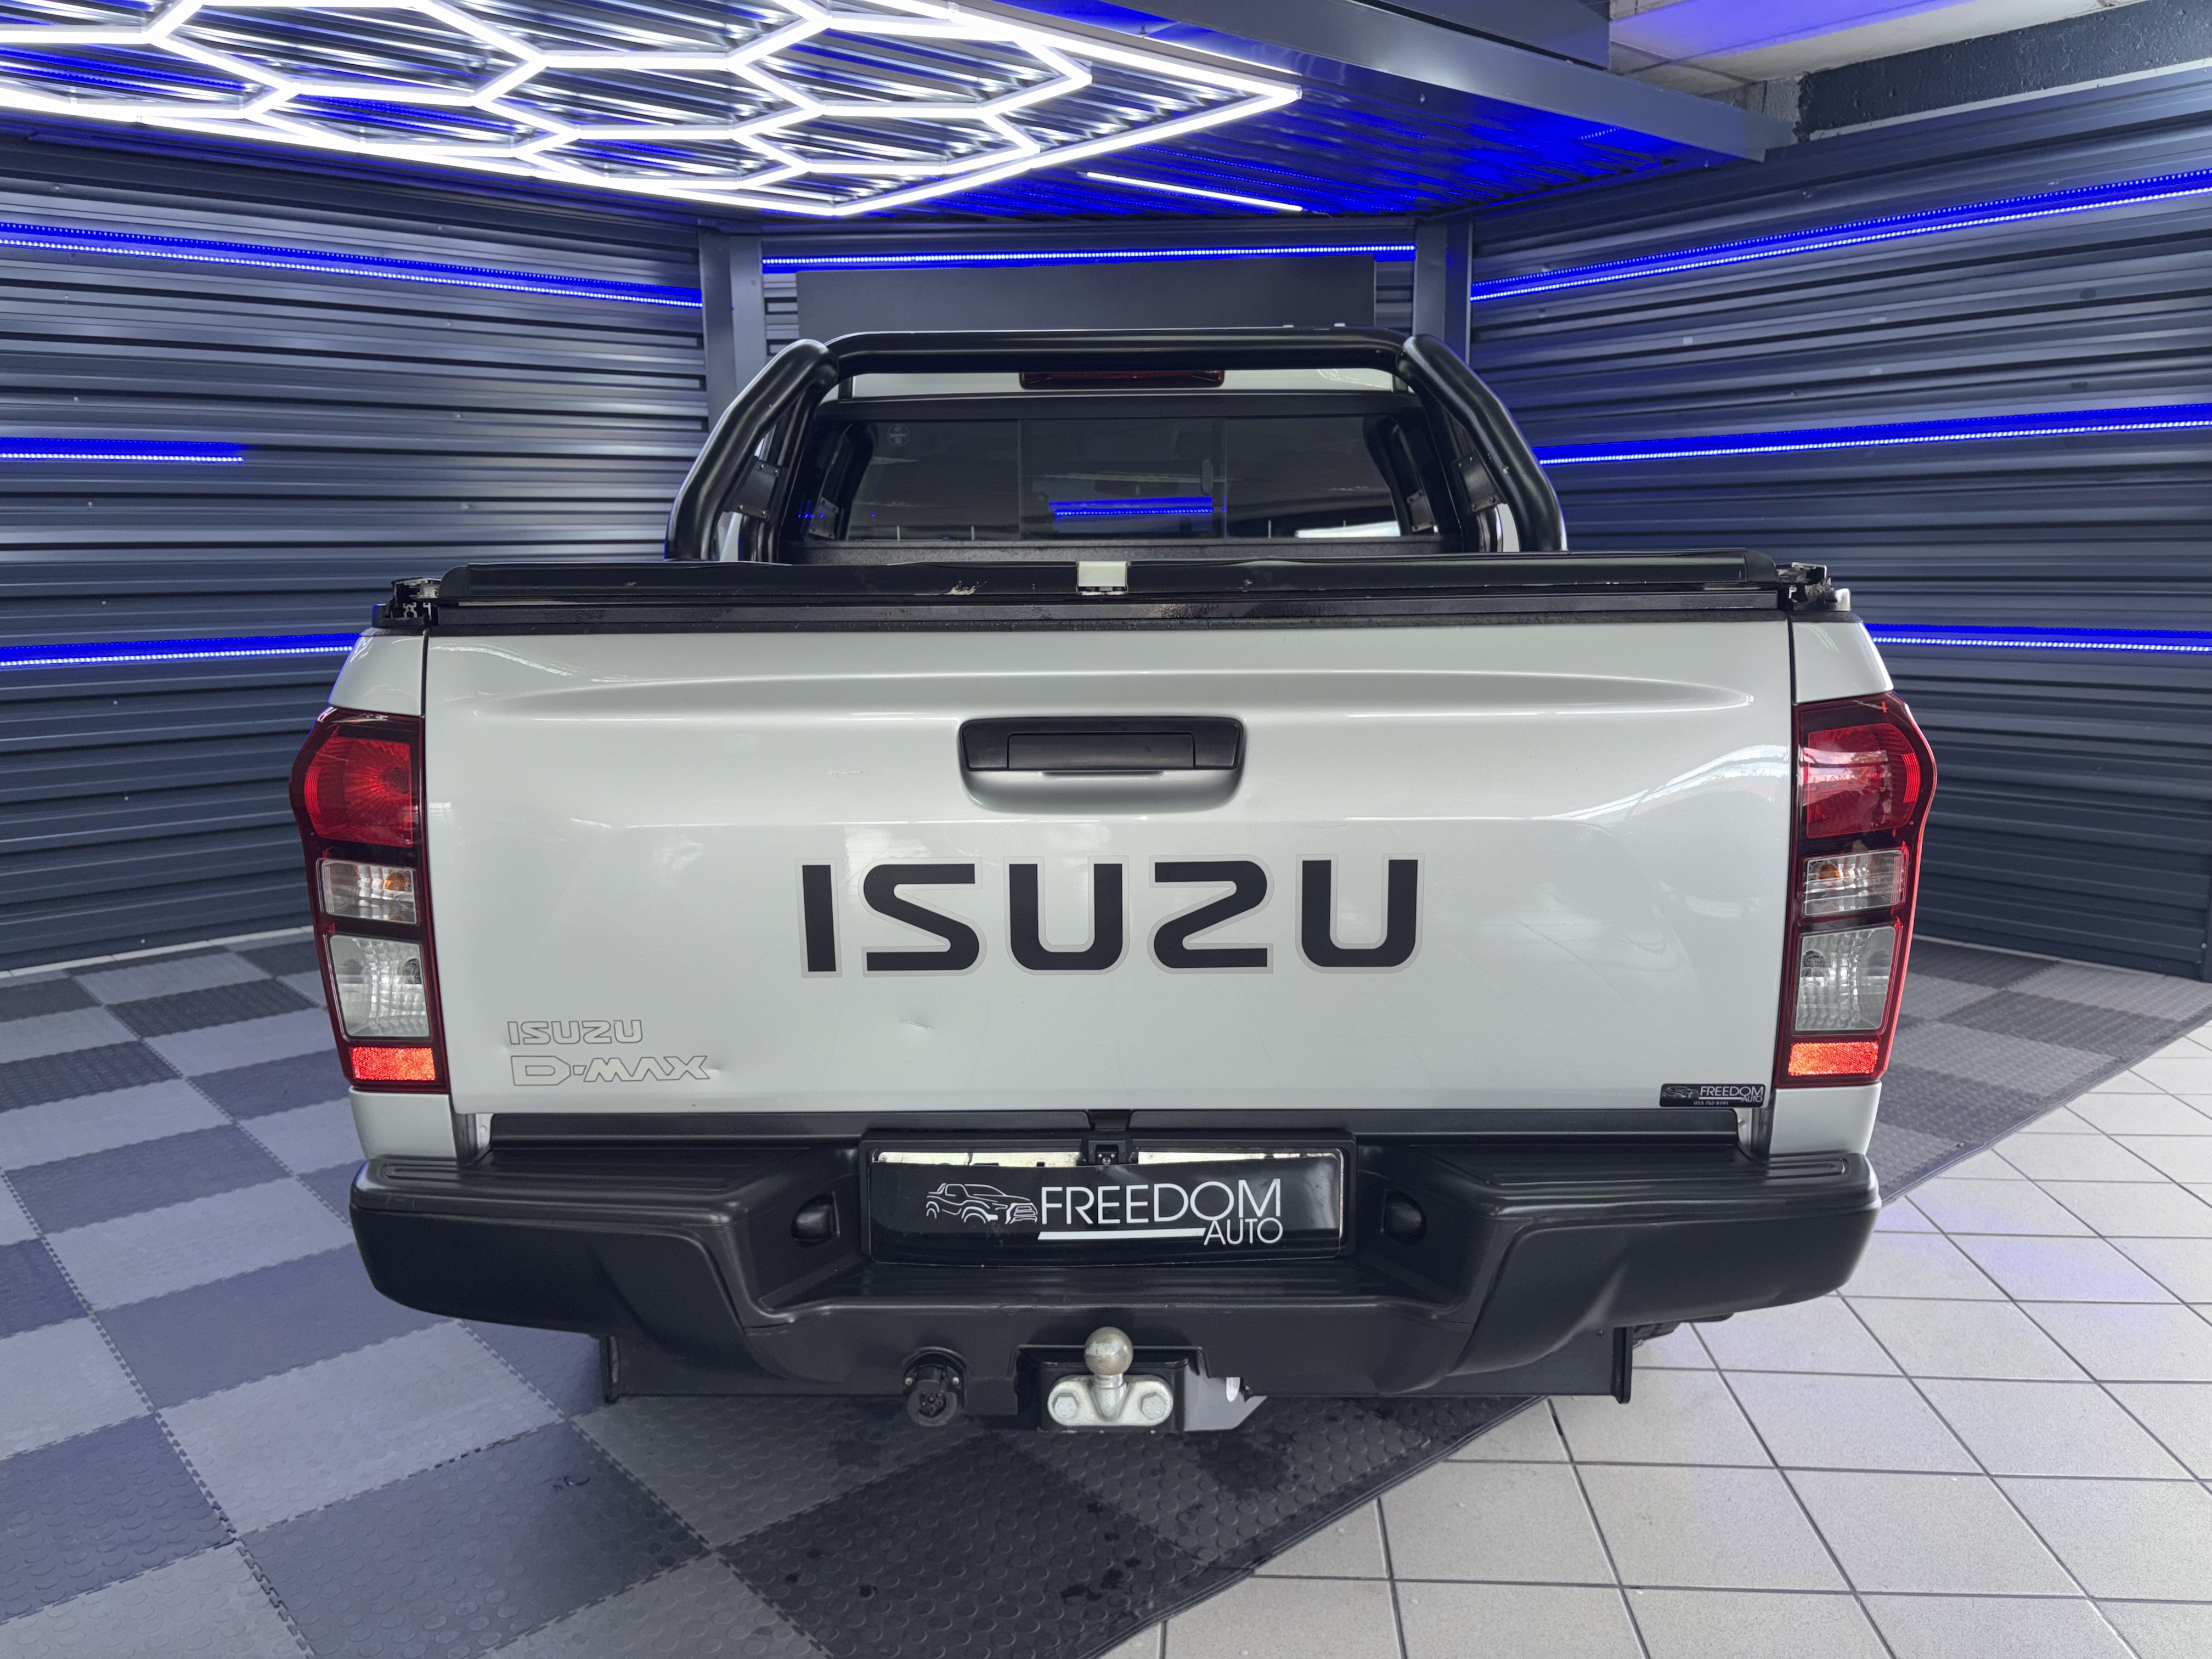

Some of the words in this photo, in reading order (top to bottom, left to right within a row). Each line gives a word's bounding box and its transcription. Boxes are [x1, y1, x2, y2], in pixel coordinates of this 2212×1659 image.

[802, 859, 1419, 972] ISUZU
[507, 1019, 643, 1045] ISUZU
[511, 1056, 710, 1086] D-MAX
[1700, 1086, 1764, 1096] FREEDOM
[1041, 1178, 1281, 1224] FREEDOM
[1204, 1217, 1283, 1245] AUTO
